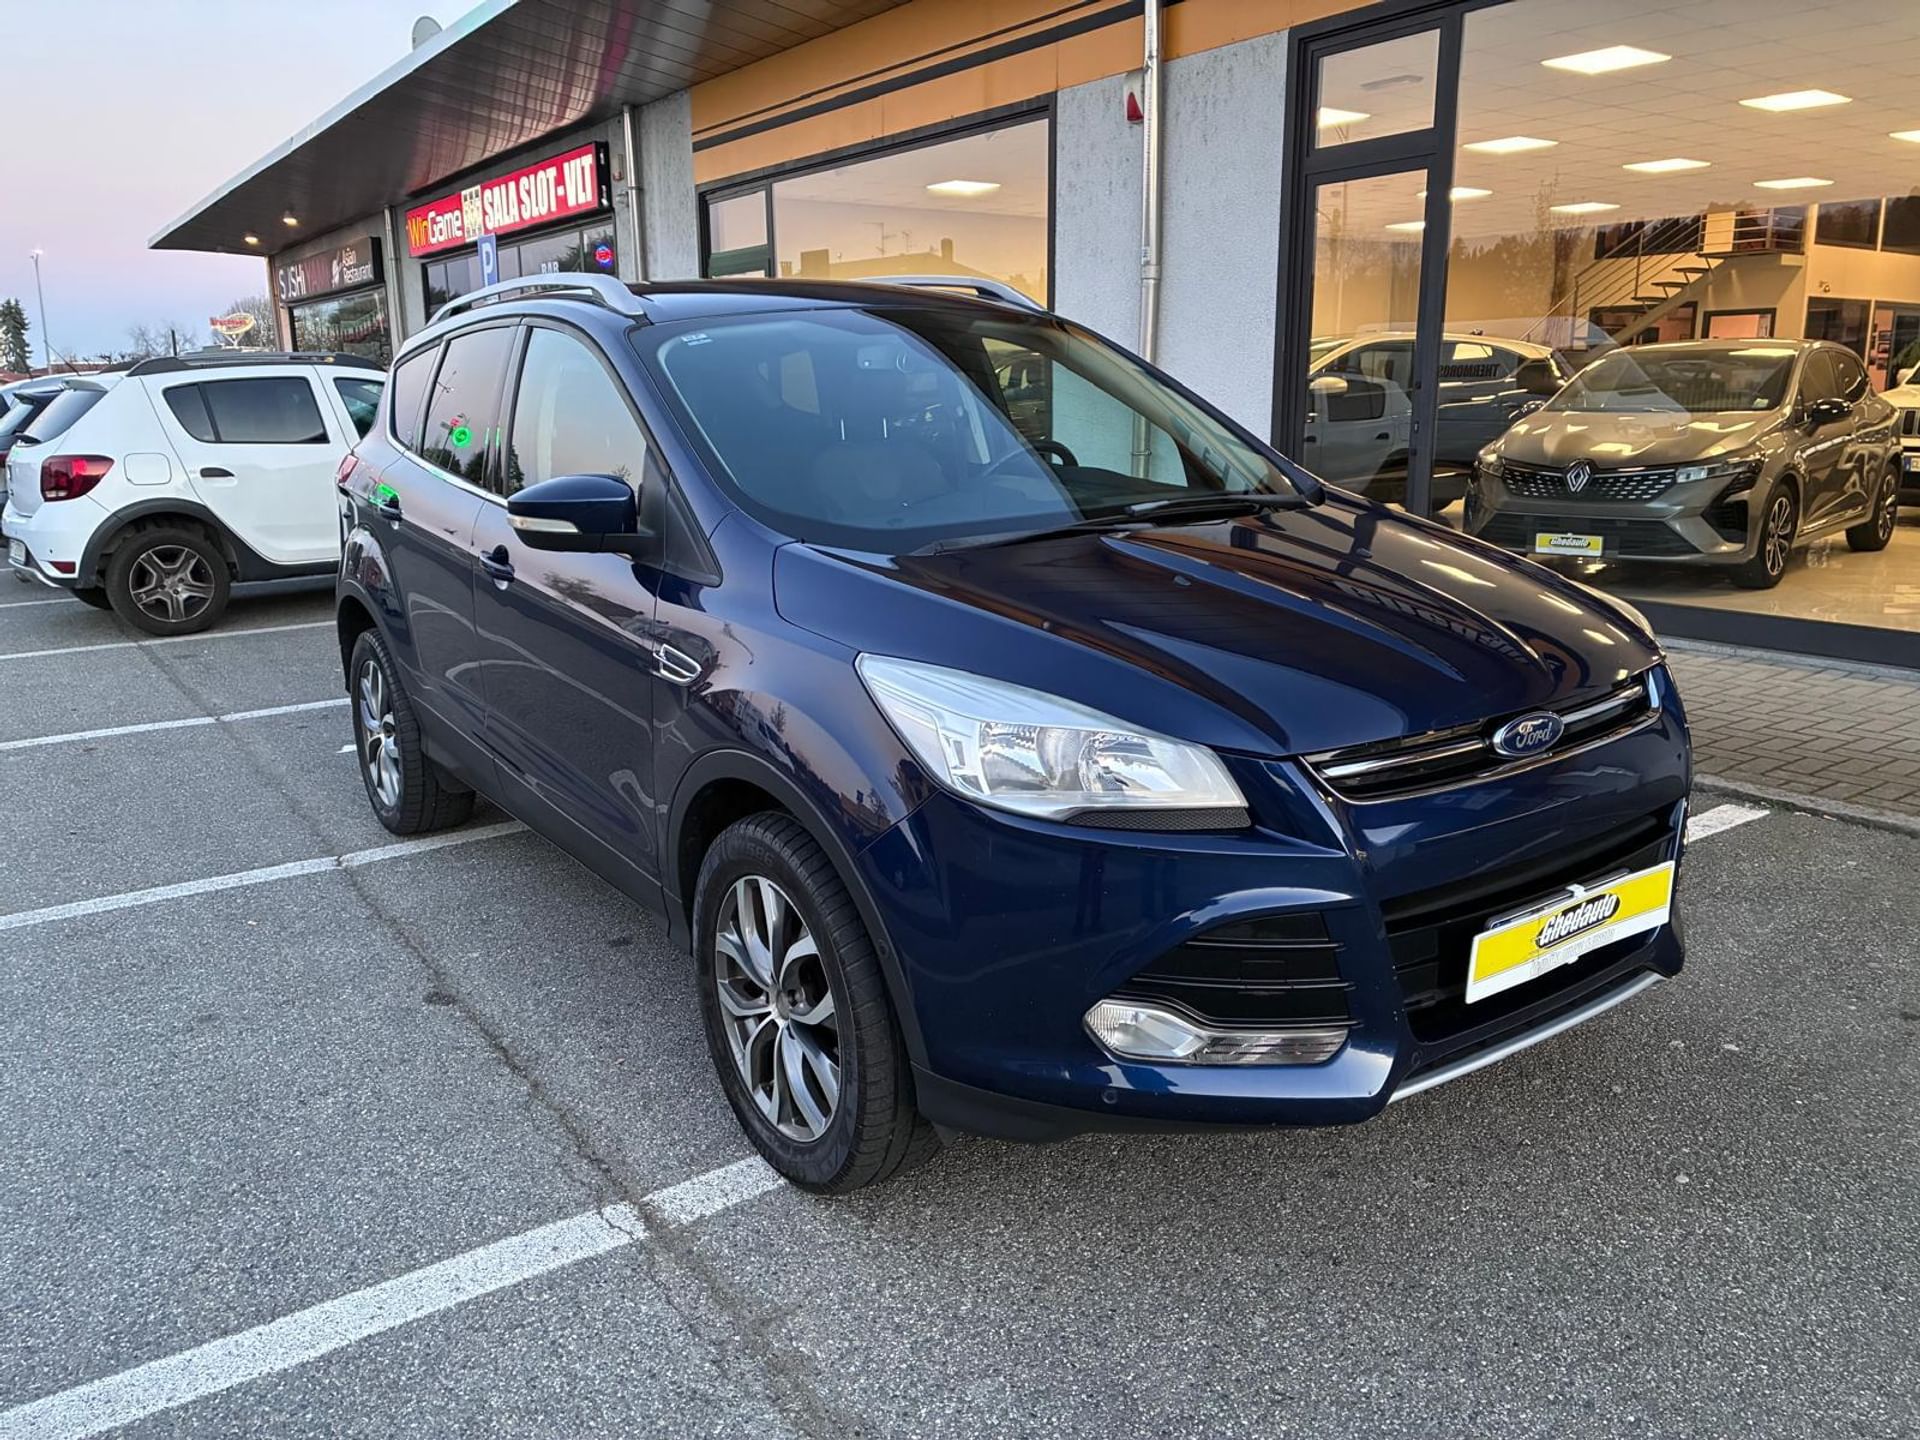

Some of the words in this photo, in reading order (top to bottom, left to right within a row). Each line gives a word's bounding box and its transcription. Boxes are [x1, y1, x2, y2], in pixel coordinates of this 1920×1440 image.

[483, 181, 520, 230] SALA
[519, 154, 593, 220] SLOT-VLT
[408, 210, 463, 248] WinGame
[342, 247, 356, 266] Asian
[481, 242, 495, 286] P
[541, 262, 559, 274] BAR
[343, 262, 374, 284] Restaurant
[1550, 536, 1589, 547] Ghedauto
[1505, 718, 1553, 748] Ford
[1537, 893, 1618, 947] Ghedauto
